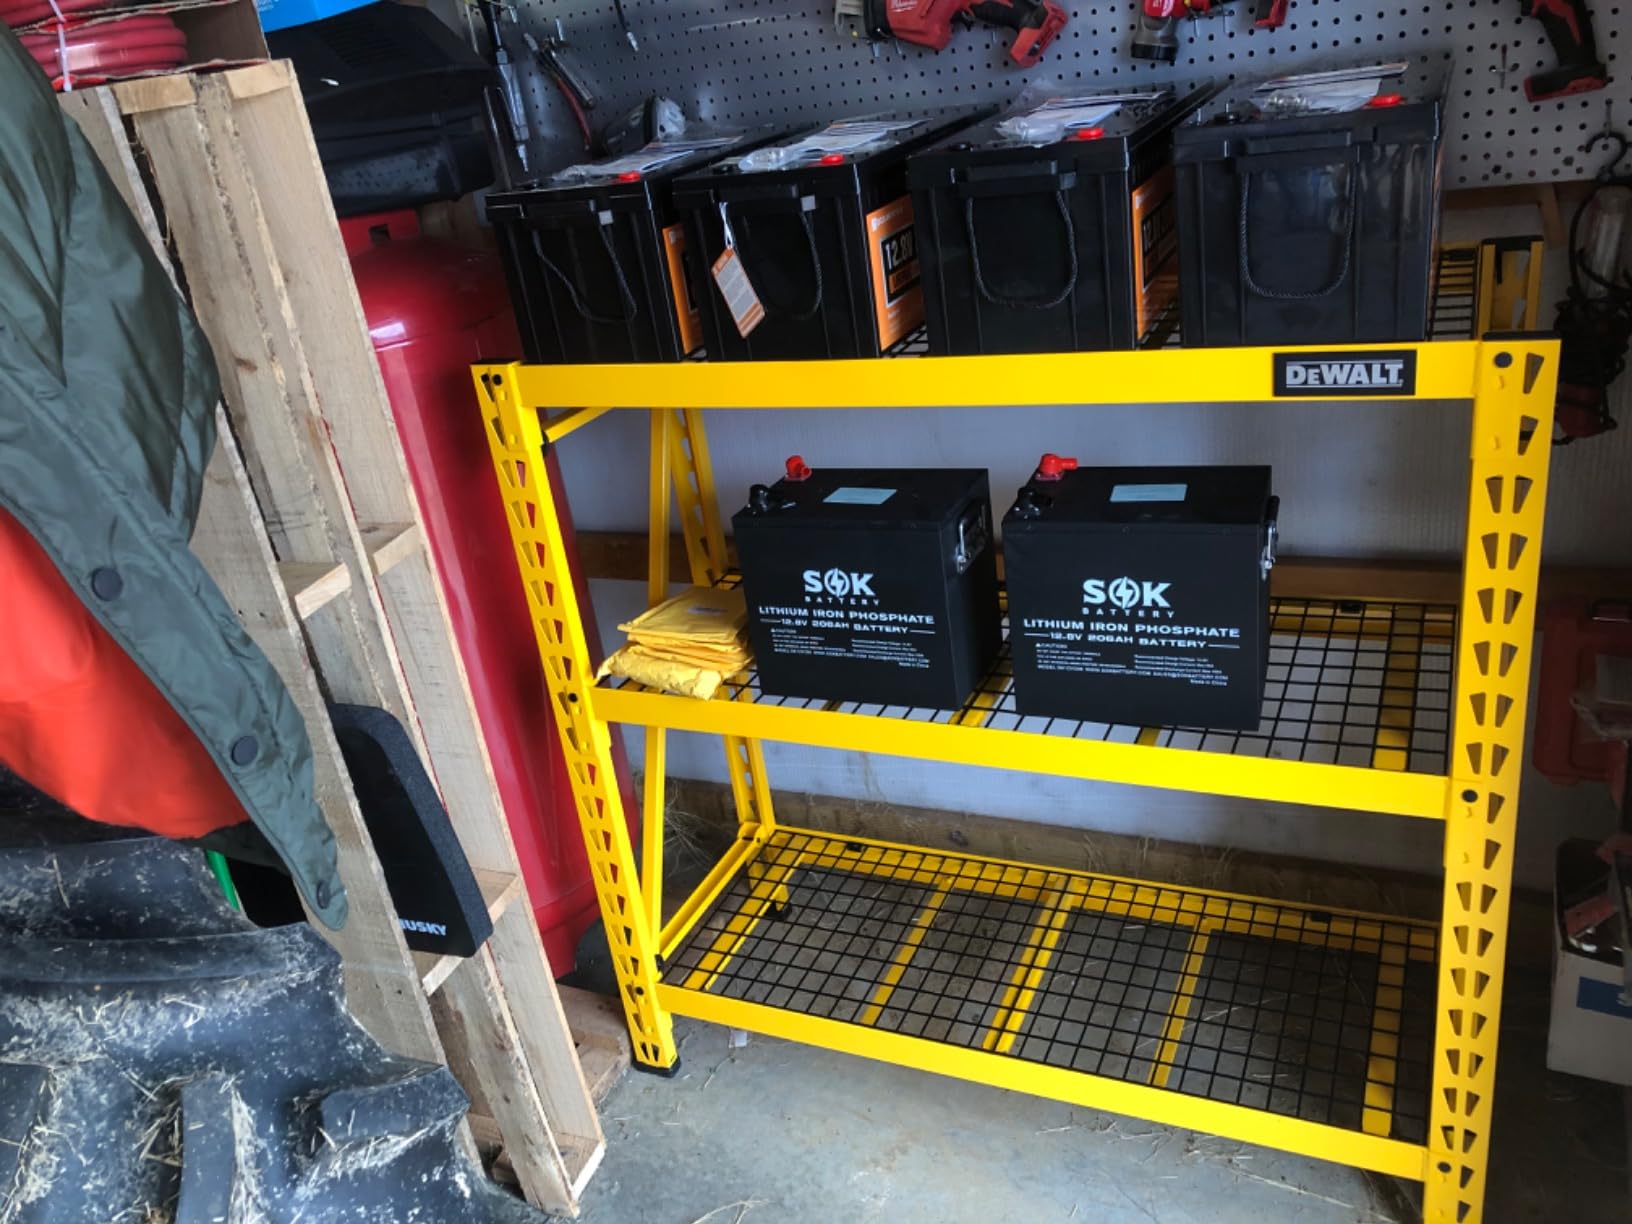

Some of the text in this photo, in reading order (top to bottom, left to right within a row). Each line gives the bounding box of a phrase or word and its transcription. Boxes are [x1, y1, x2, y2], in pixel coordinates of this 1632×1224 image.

[803, 568, 875, 597] SOK
[1082, 576, 1171, 609] SOK
[804, 596, 880, 606] BATTERY
[759, 606, 935, 625] LITHIUM IRON PHOSPHATE
[1081, 607, 1175, 618] BATTERY
[853, 623, 908, 634] BATTERY
[1023, 618, 1240, 638] LITHIUM IRON PHOSPHATE
[1139, 637, 1207, 648] BATTERY
